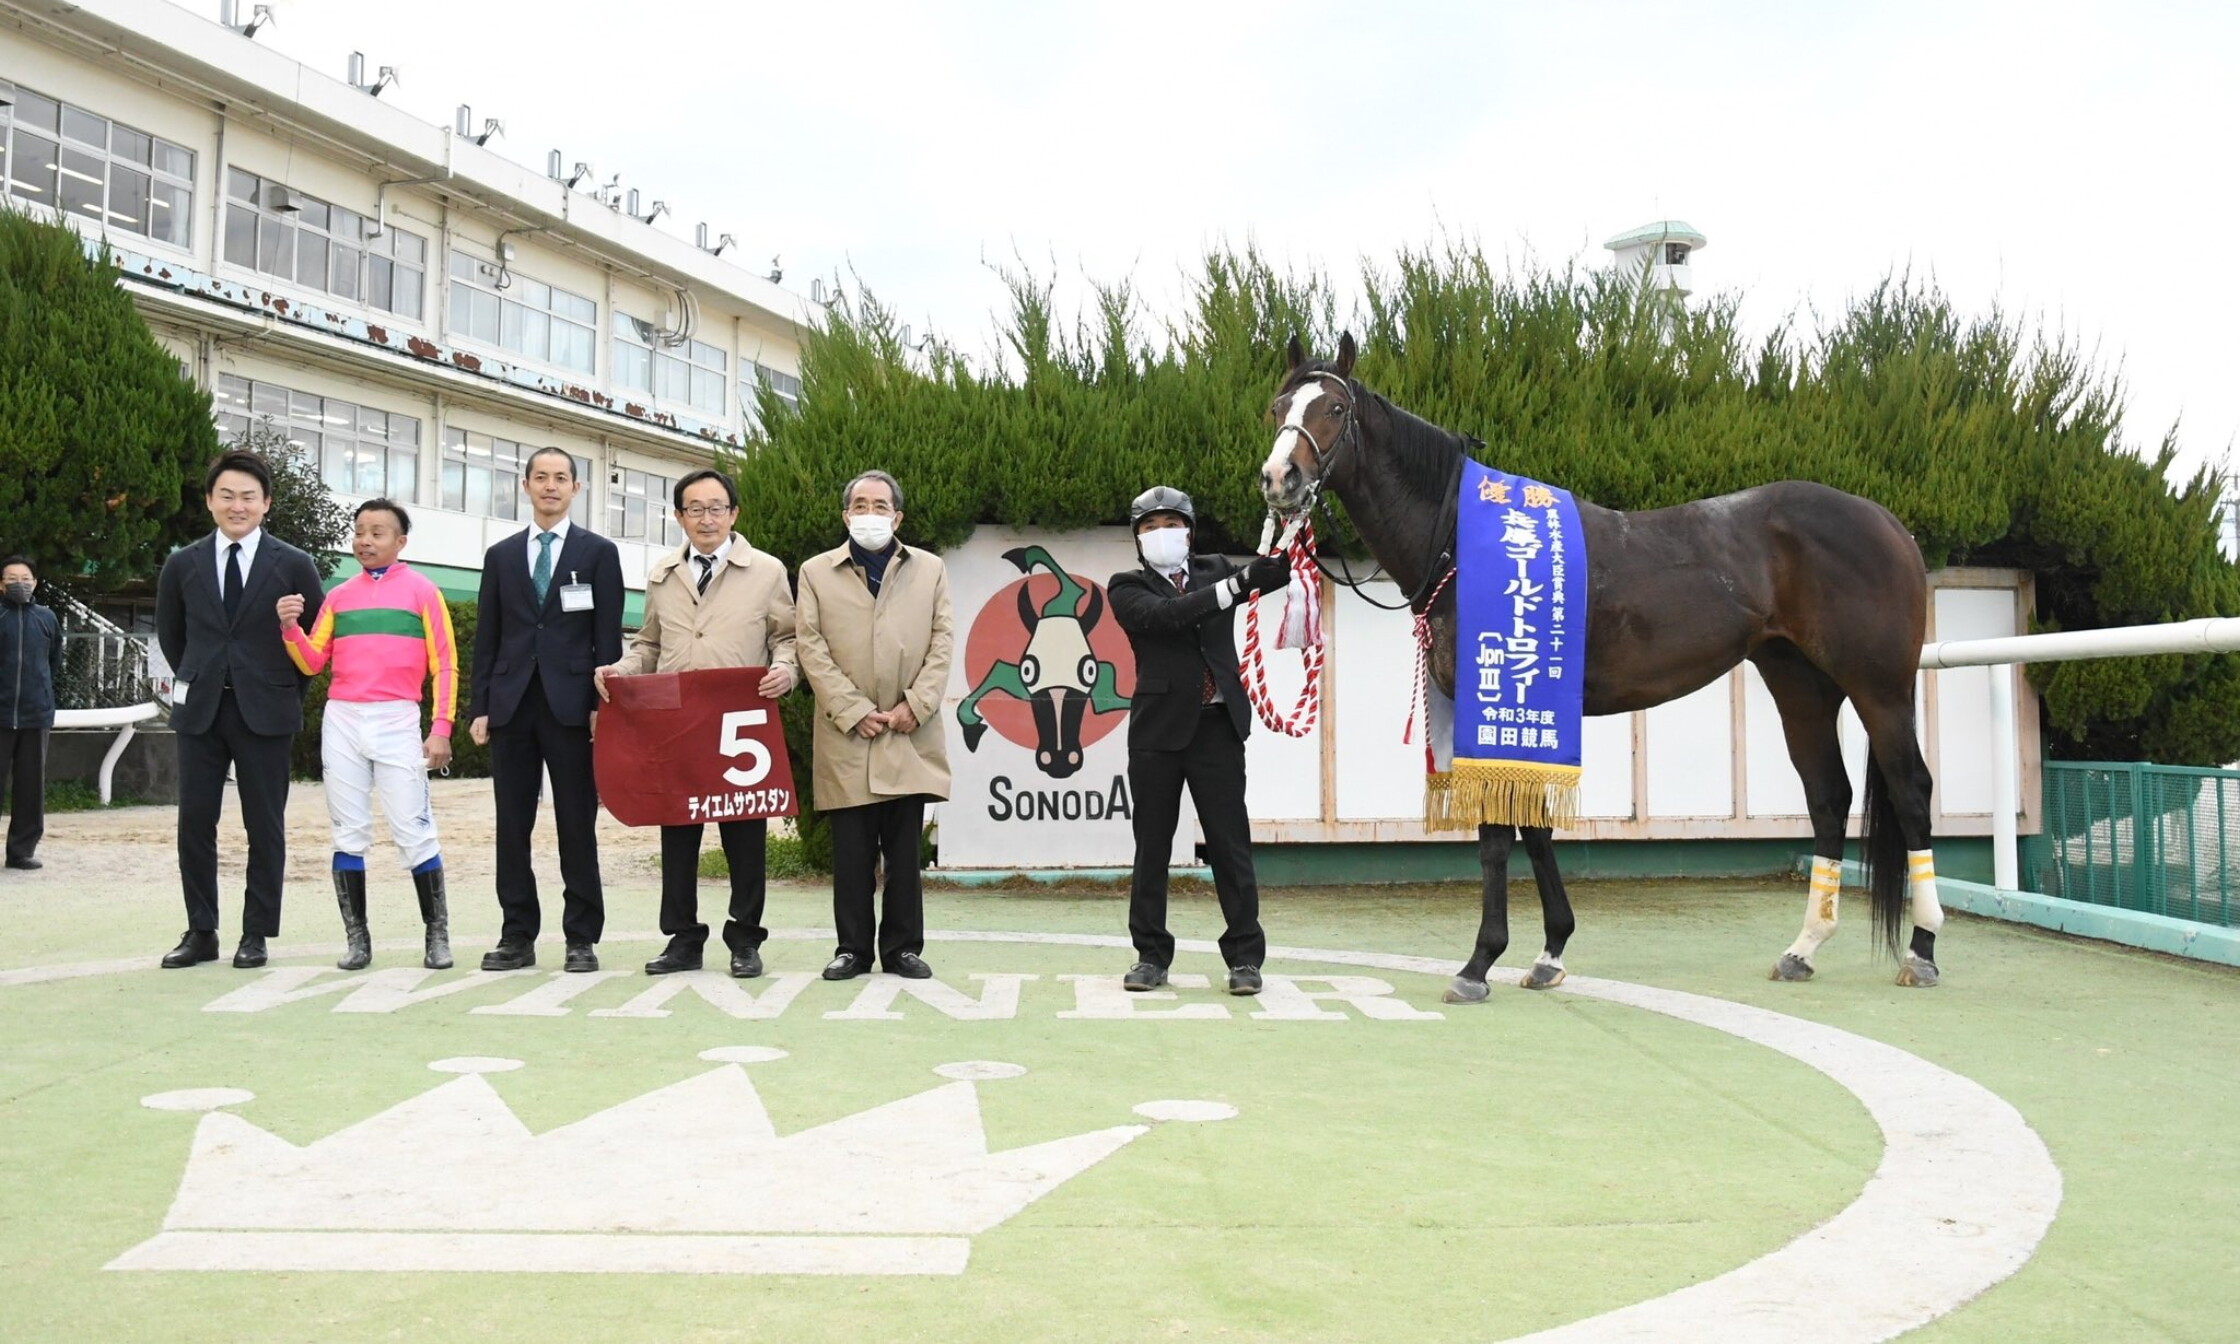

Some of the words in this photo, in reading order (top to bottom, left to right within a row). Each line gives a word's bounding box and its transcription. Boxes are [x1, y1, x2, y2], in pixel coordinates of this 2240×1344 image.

[1478, 475, 1561, 508] 優勝
[1499, 508, 1543, 704] 兵庫ゴールドトロフィー
[1482, 706, 1555, 725] 令和3年度
[719, 709, 772, 786] 5
[1477, 725, 1559, 749] 園田競馬
[688, 788, 790, 820] テイエムサウスダン
[201, 965, 1446, 1020] WINNER
